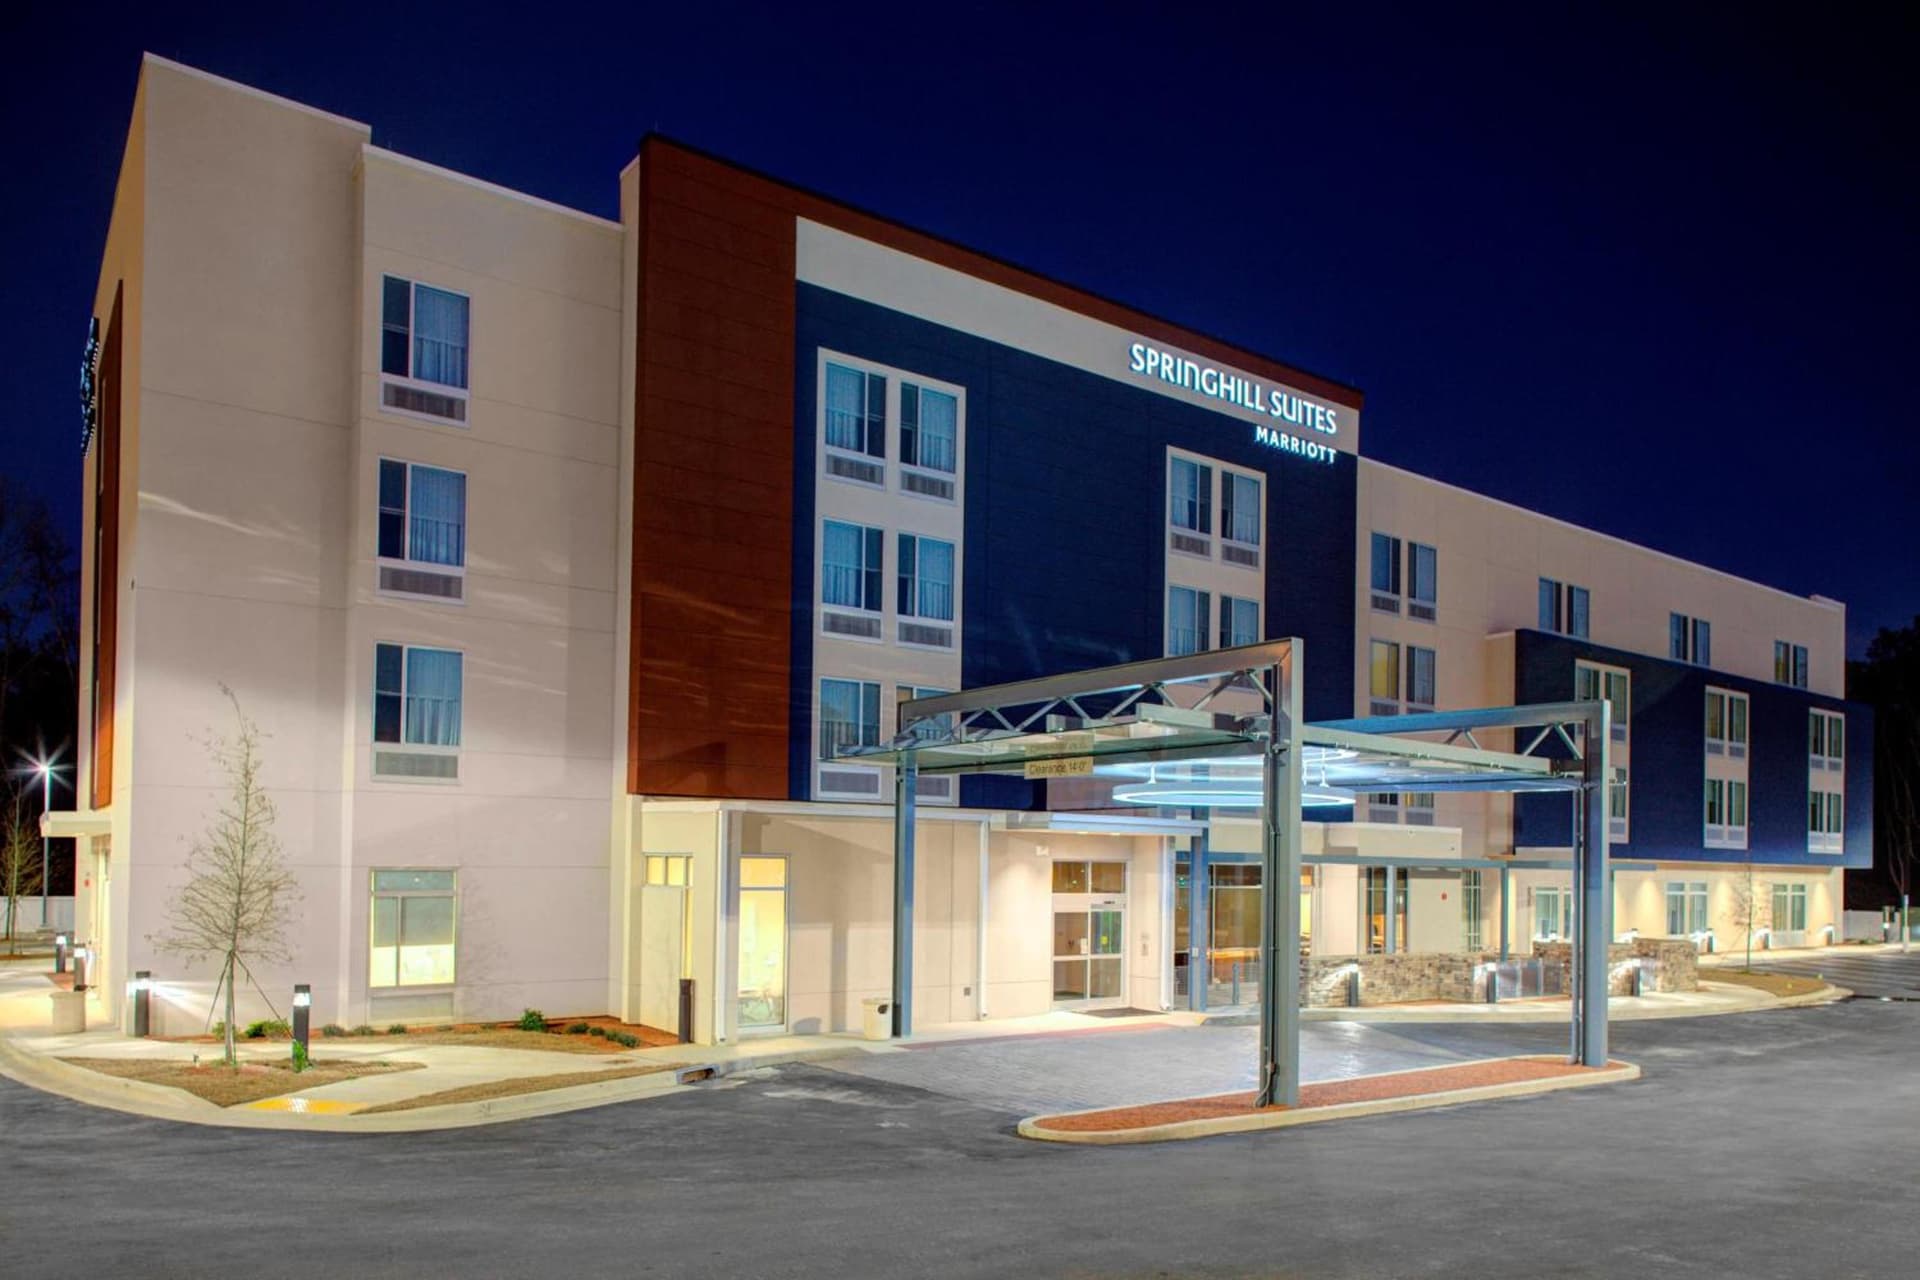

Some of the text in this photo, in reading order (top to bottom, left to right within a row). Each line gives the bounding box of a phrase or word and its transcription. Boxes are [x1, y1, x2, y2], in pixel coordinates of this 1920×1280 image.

[1130, 343, 1337, 434] SPRINGHILL SUITES
[1256, 425, 1337, 464] MARRIOTT
